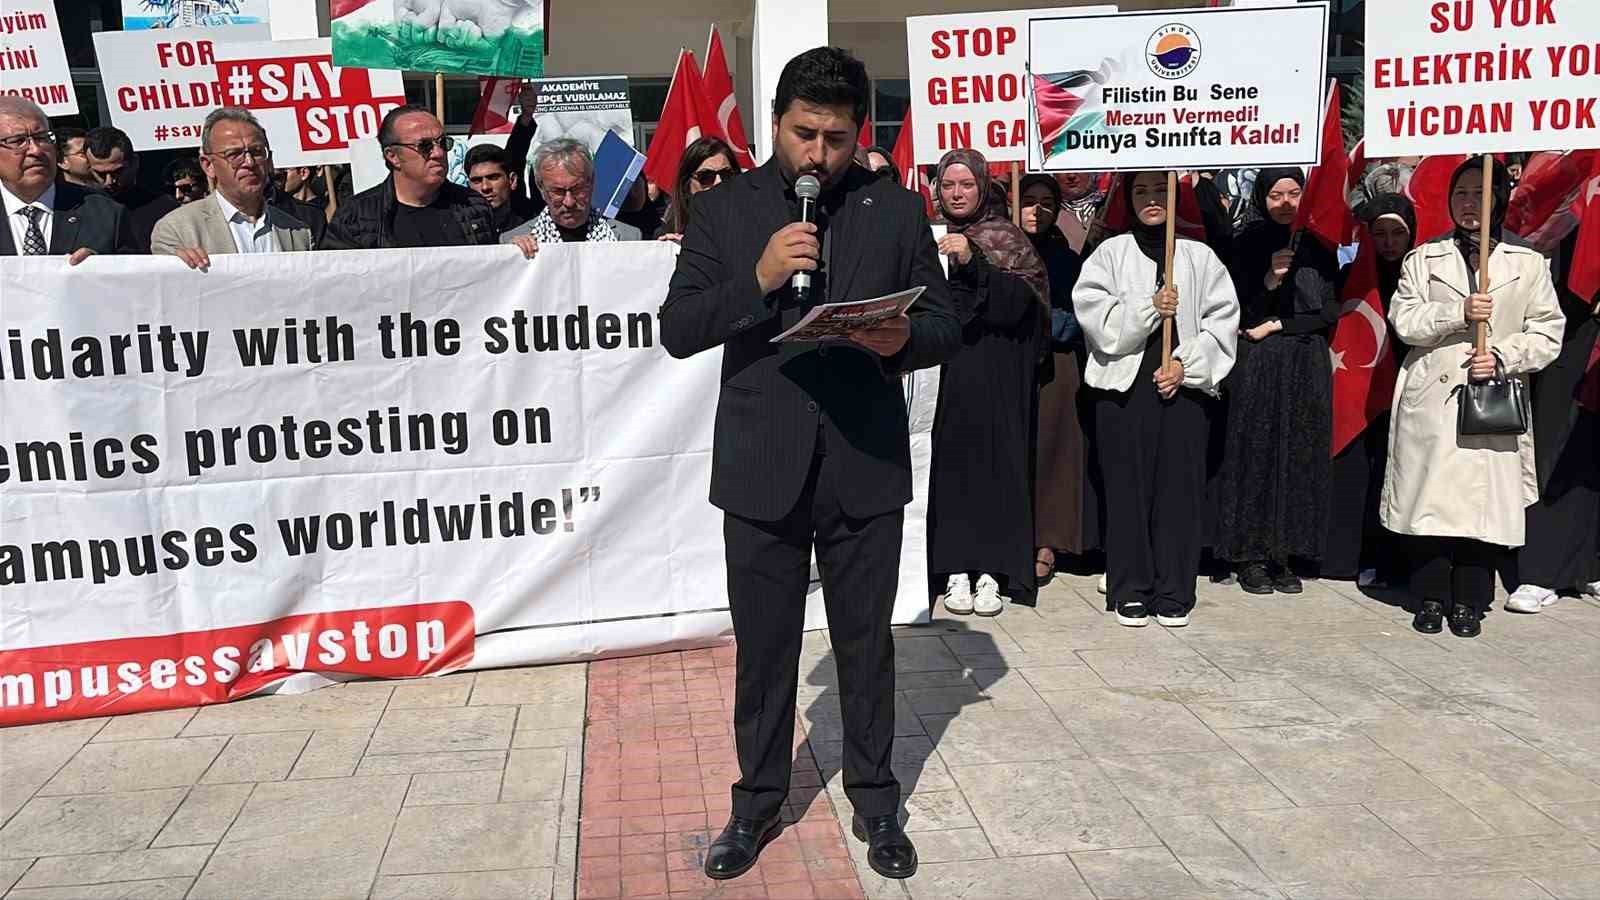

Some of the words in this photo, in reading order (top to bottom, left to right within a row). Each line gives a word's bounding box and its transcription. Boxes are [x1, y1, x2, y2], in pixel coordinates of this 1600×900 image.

[1430, 0, 1474, 33] SU
[1488, 0, 1556, 28] YOK
[157, 40, 215, 68] FOR
[931, 27, 1017, 59] STOP
[1374, 43, 1533, 89] ELEKTRİK
[0, 84, 69, 105] RUM
[228, 60, 342, 105] #SAY
[541, 80, 600, 92] AKADEMİYE
[565, 92, 626, 103] VURULAMAZ
[927, 73, 1026, 106] GENO
[1102, 86, 1166, 104] Filistin
[1173, 85, 1198, 101] Bu
[1210, 83, 1259, 100] Sene
[1106, 108, 1166, 126] Mezun
[1173, 105, 1259, 124] Vermedi!
[1387, 100, 1513, 137] VİCDAN
[1528, 97, 1597, 131] YOK
[937, 121, 972, 151] IN
[1066, 129, 1137, 153] Dünya
[1145, 126, 1222, 148] Sınıfta
[1230, 123, 1300, 145] Kaldı!
[233, 315, 355, 367] with
[378, 312, 461, 359] the
[185, 406, 468, 477] protesting
[492, 406, 552, 446] on
